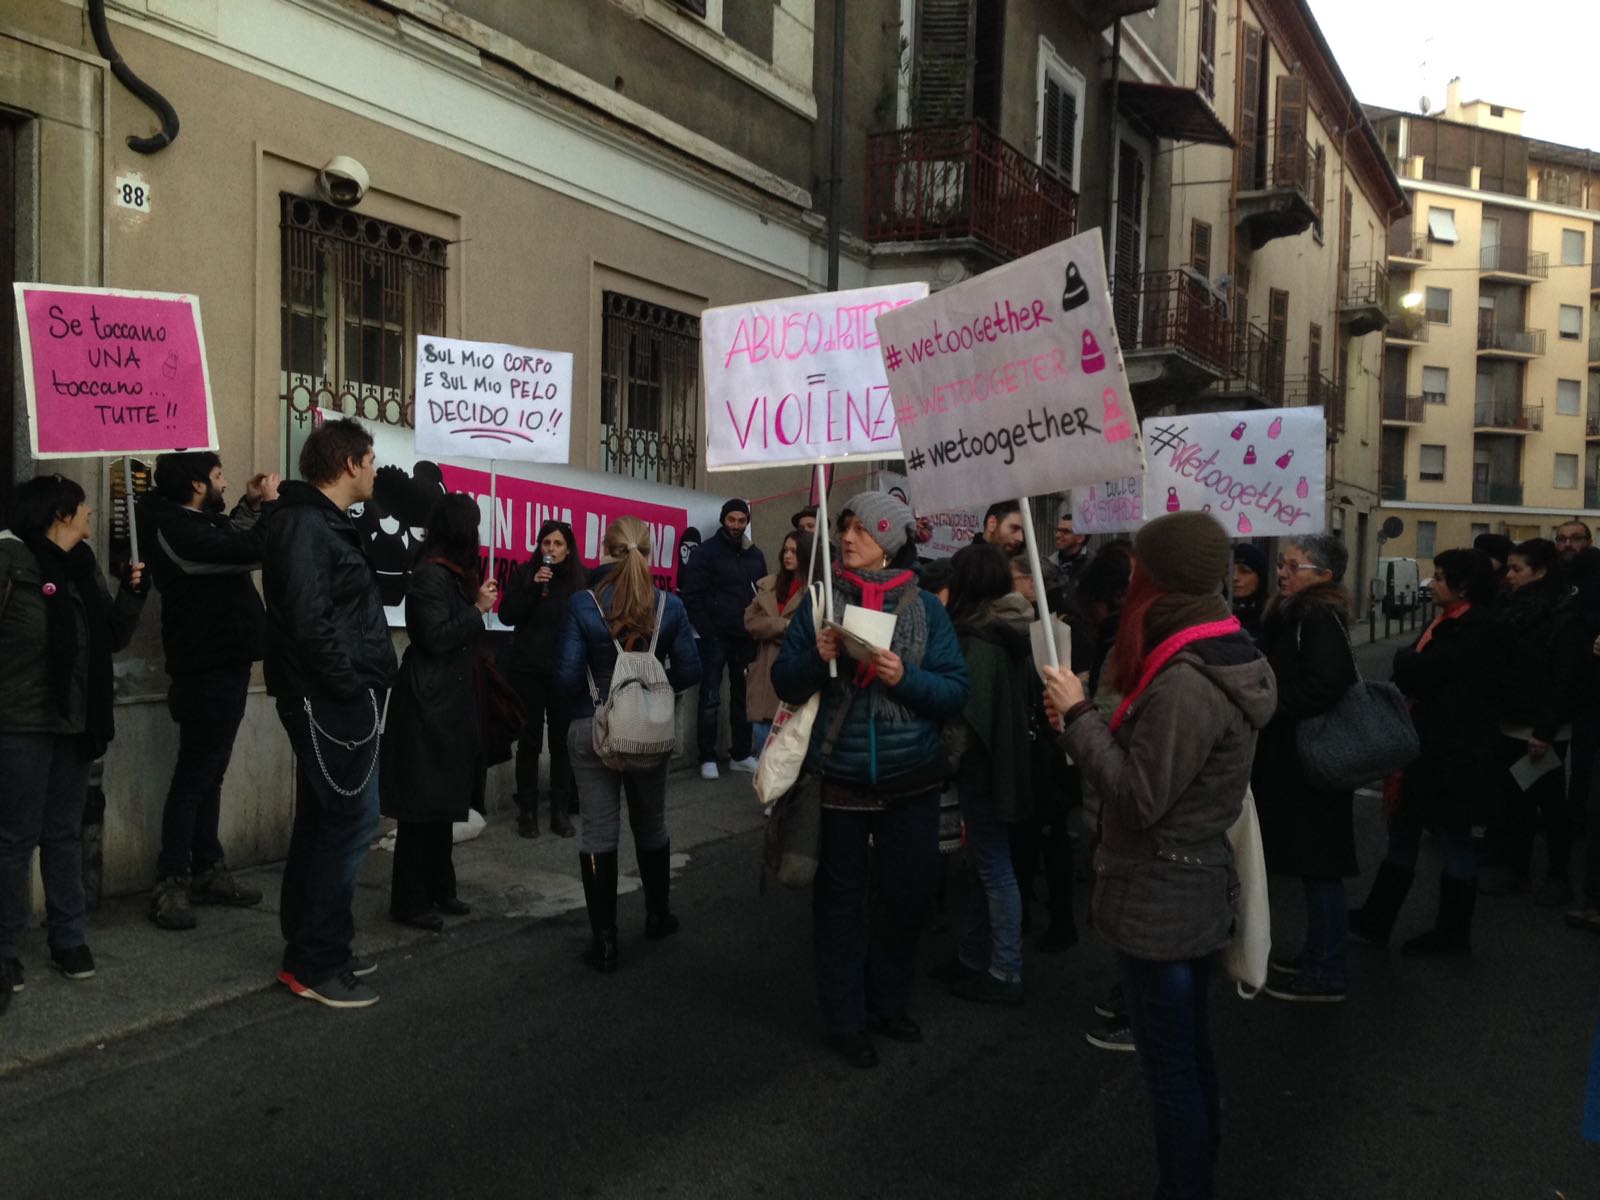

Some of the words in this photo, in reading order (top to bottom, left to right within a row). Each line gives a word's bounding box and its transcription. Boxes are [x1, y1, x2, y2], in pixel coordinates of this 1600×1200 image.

[123, 183, 144, 207] 88
[49, 305, 83, 339] Se
[90, 305, 167, 342] toccano
[725, 311, 824, 369] ABUSO
[88, 346, 141, 368] UNA
[424, 343, 455, 364] SUL
[503, 353, 552, 374] CORPO
[424, 372, 434, 387] E
[440, 371, 467, 391] SUL
[510, 378, 557, 400] PELO
[428, 399, 509, 426] DECIDO
